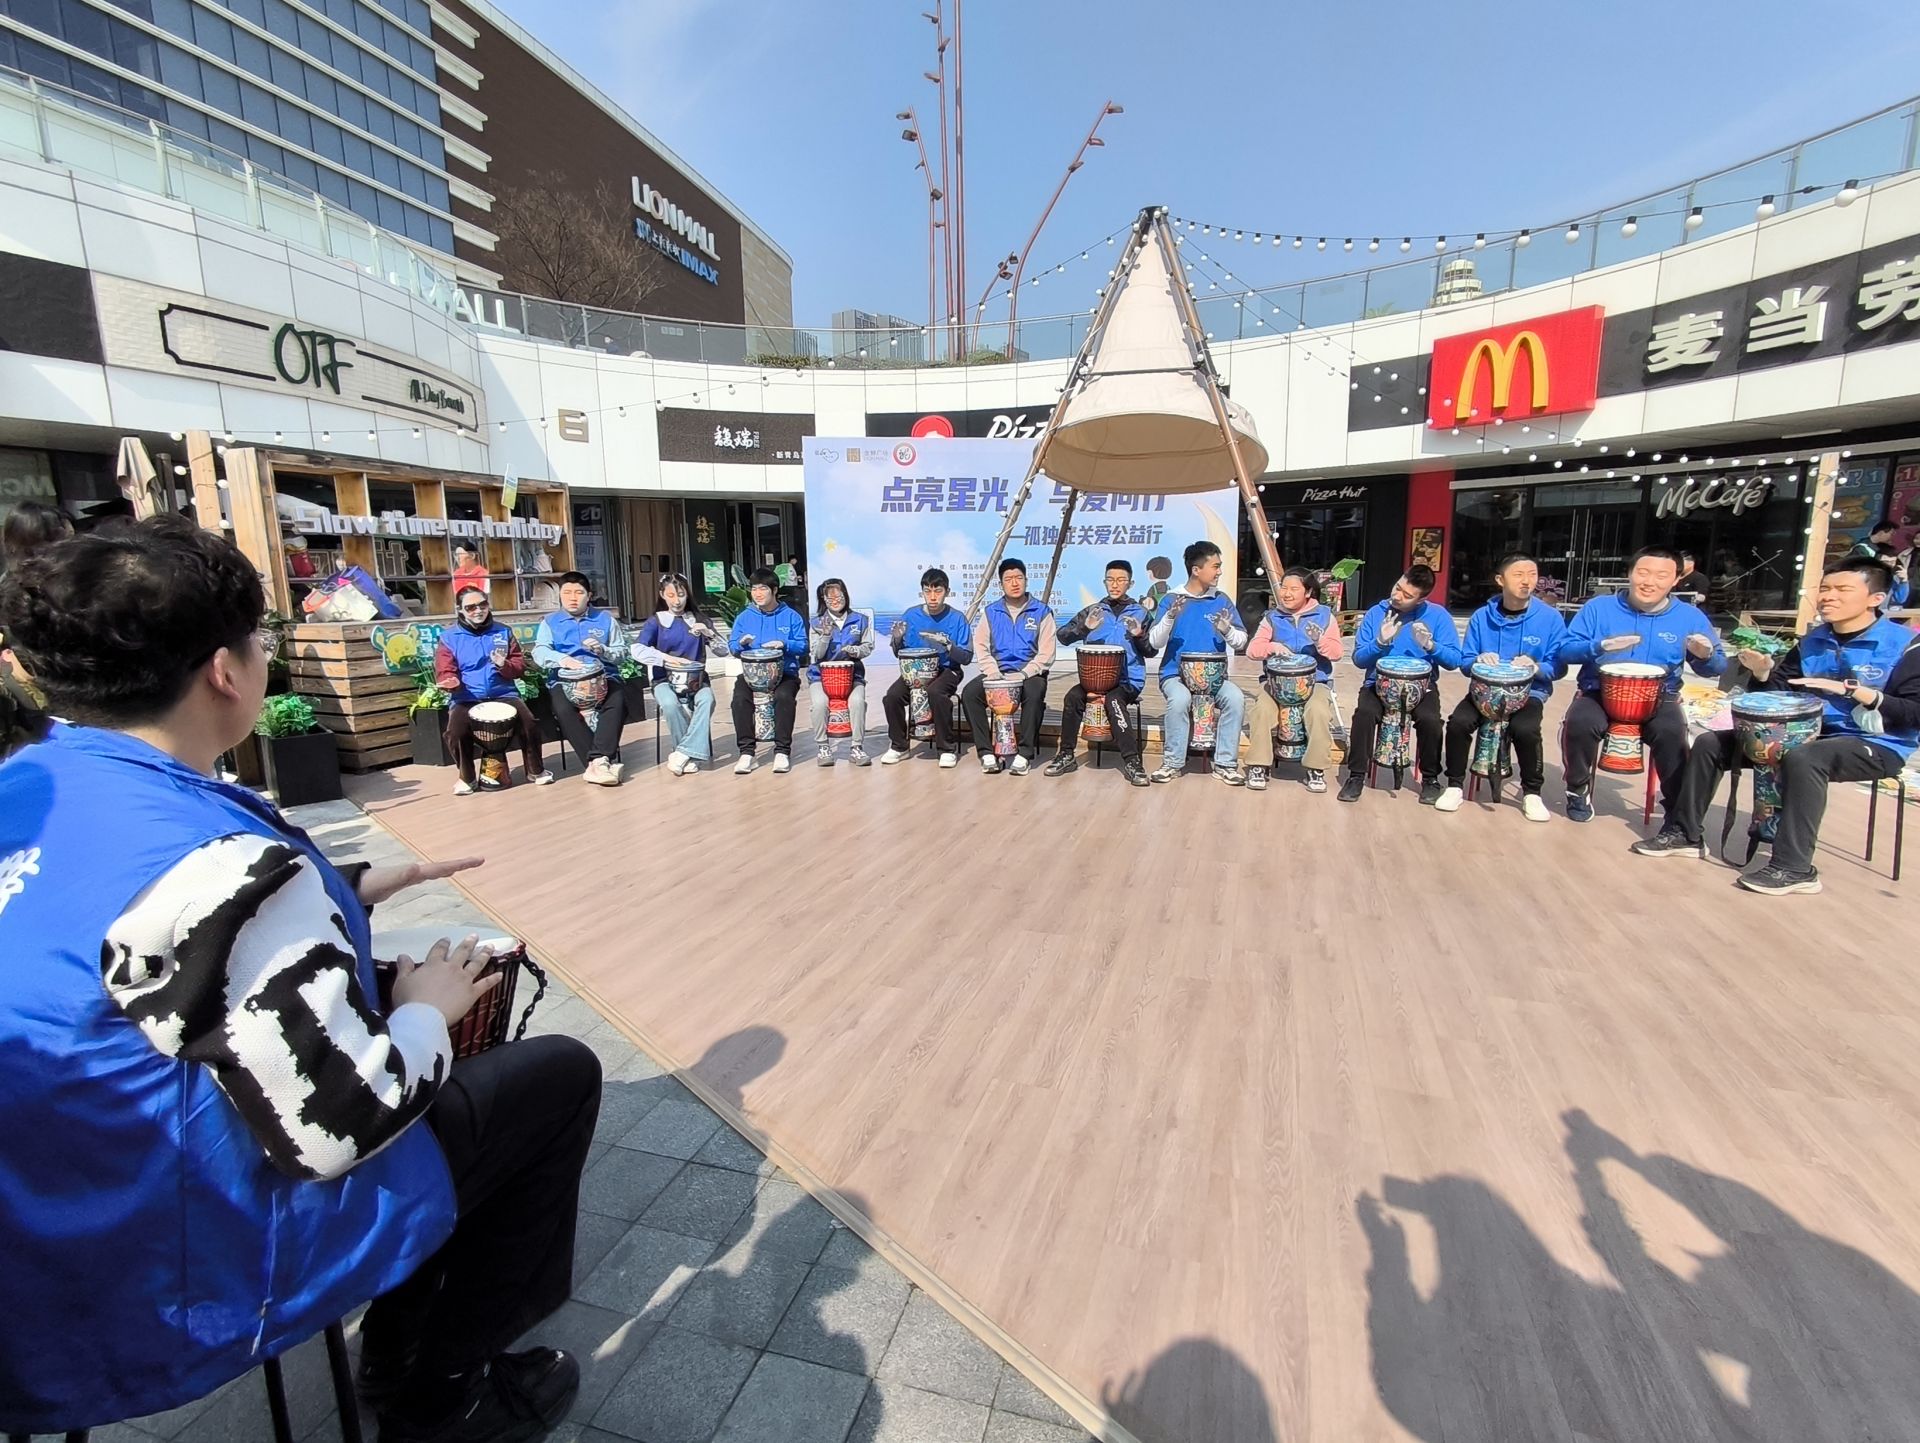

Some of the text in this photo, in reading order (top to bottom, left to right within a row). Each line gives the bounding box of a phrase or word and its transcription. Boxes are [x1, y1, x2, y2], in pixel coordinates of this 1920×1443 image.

[880, 477, 1010, 513] 点亮星光
[1301, 485, 1368, 503] Pizza Hut
